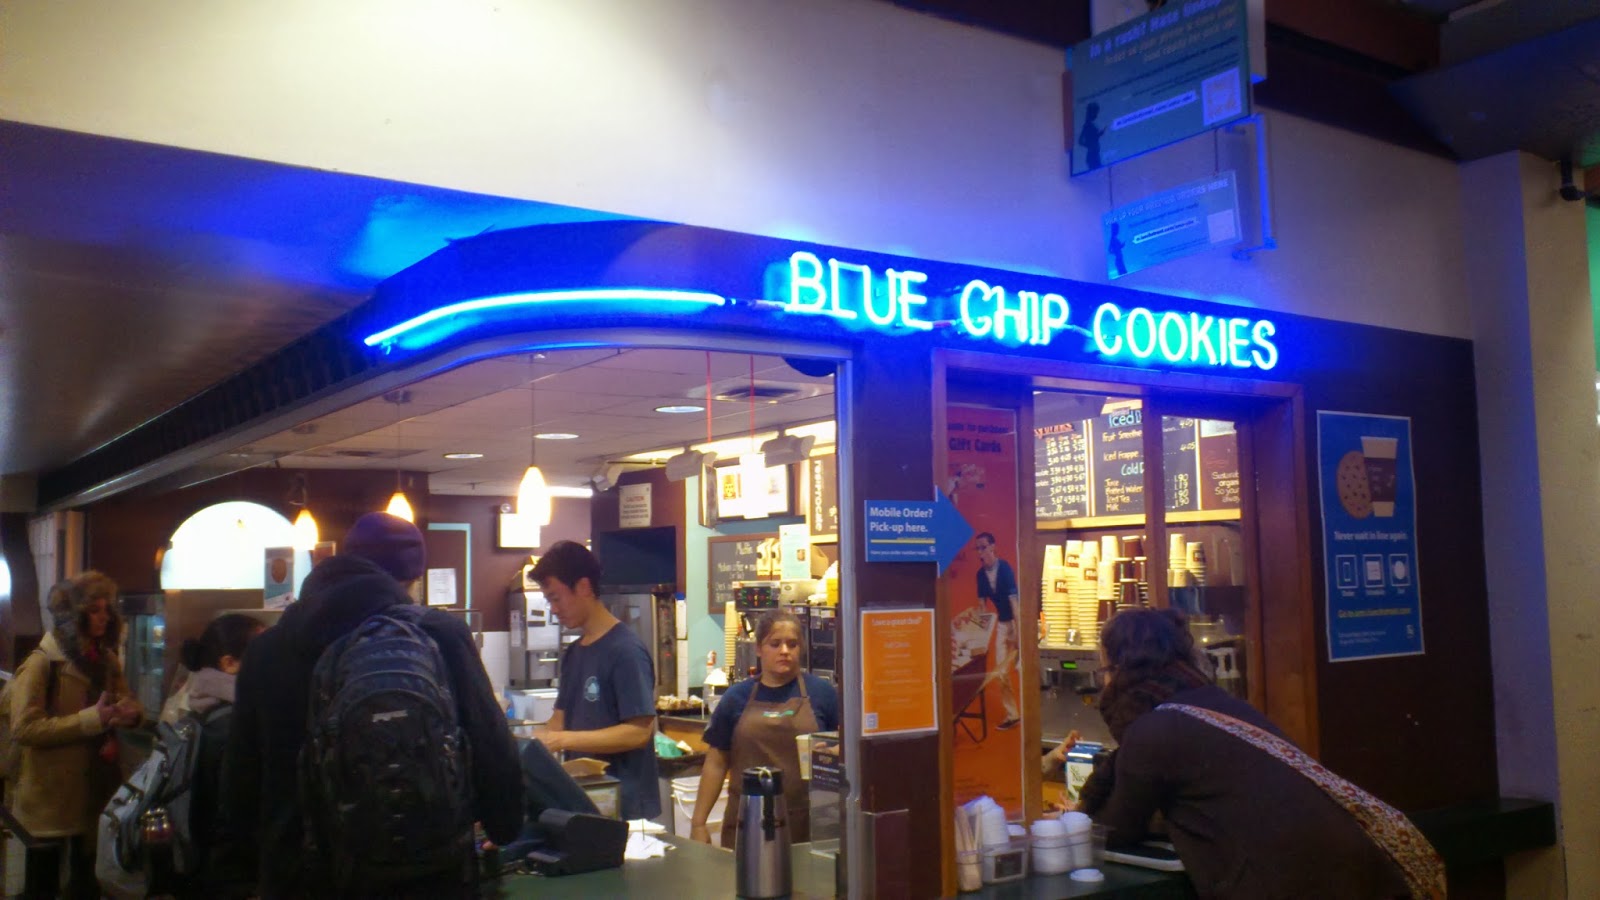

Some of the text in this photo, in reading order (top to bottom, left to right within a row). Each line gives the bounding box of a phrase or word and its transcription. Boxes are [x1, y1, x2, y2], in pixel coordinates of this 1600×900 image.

[786, 251, 1278, 370] BLUE CHIP COOKIES
[1109, 409, 1134, 428] Iced
[949, 437, 1002, 453] Gift Cards
[1121, 462, 1139, 476] Cold
[870, 506, 934, 519] Mobile Order?
[870, 521, 929, 534] Pick-up here.
